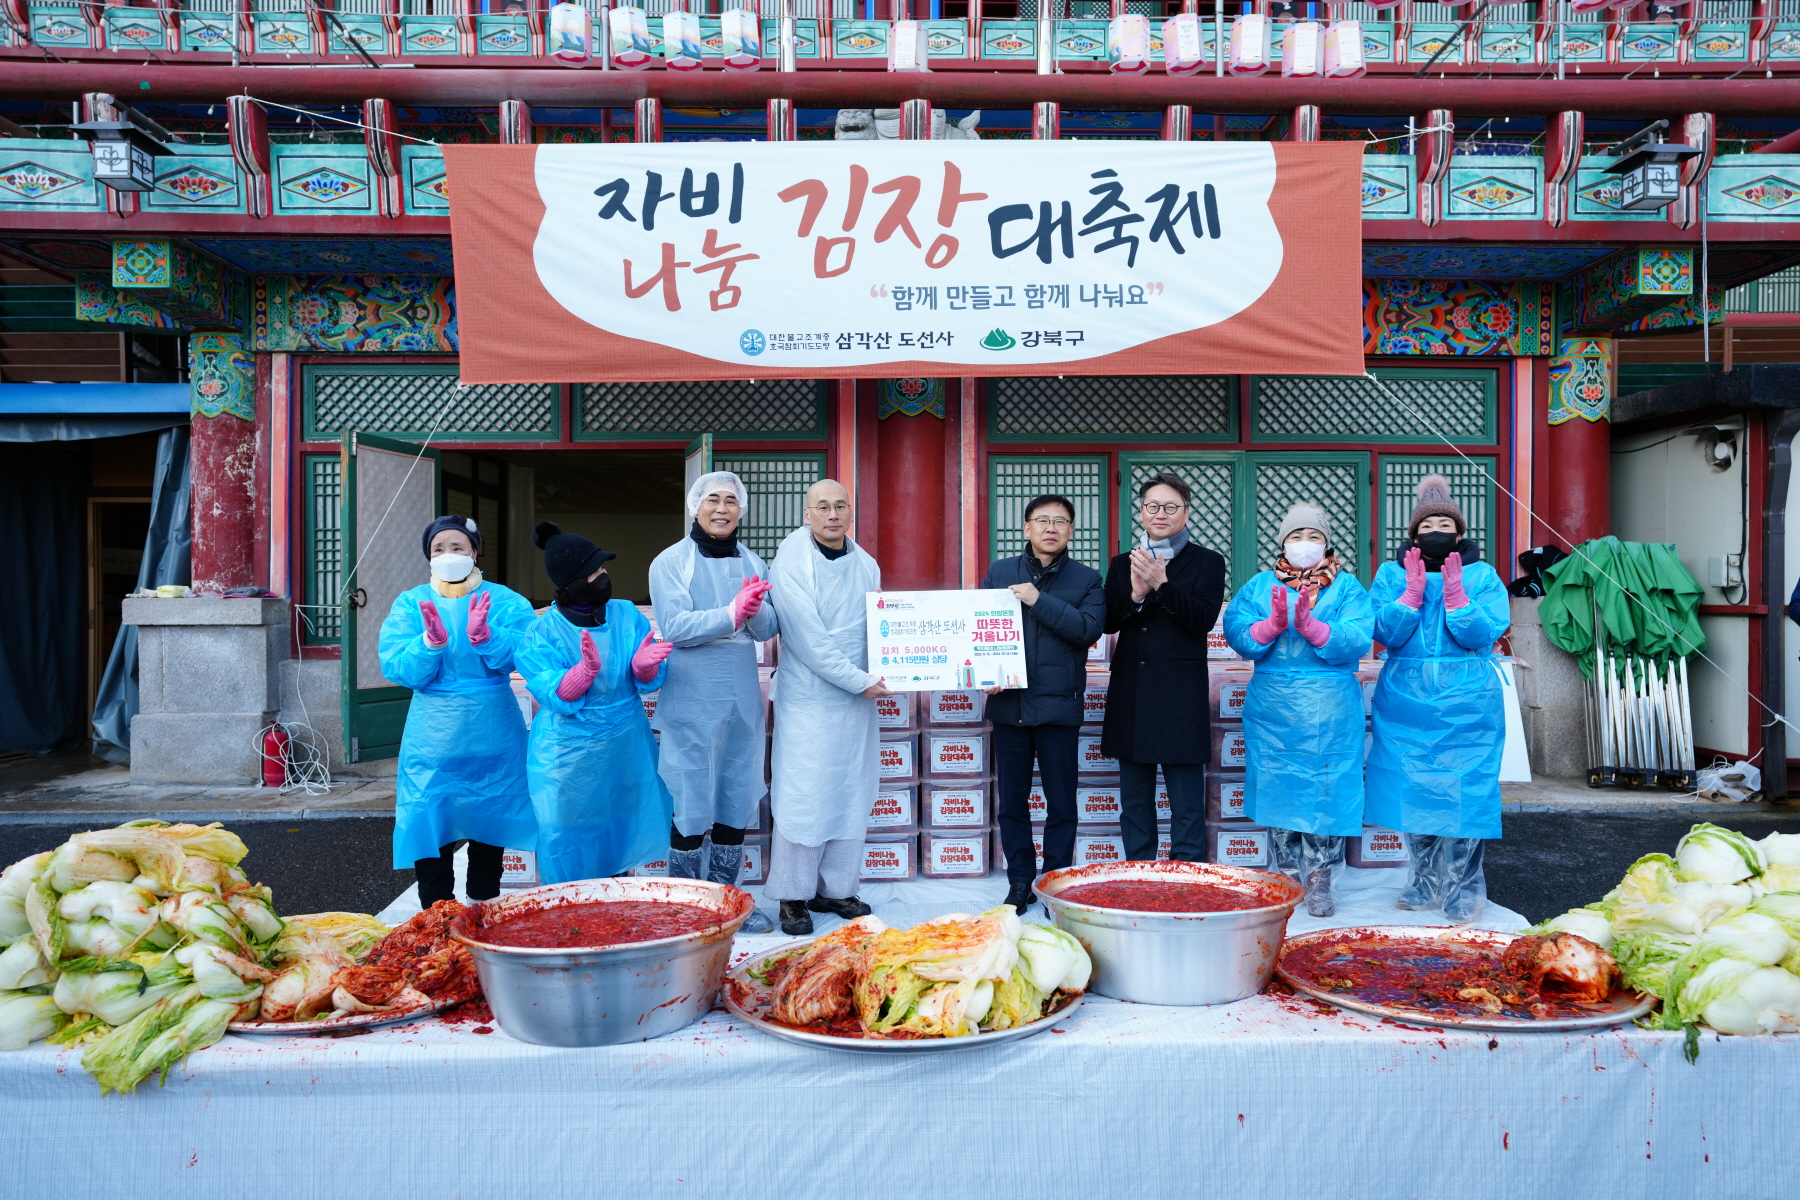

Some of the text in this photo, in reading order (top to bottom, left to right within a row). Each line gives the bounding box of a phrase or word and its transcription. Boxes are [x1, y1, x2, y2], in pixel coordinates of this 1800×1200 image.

[594, 162, 744, 231] 자비
[777, 161, 1221, 279] 김장 대축제
[623, 229, 760, 312] 나눔
[946, 285, 1017, 310] 만들고
[1023, 283, 1070, 309] 함께
[769, 332, 831, 342] 대한불교조계종
[835, 330, 955, 350] 삼각산 도선사
[1020, 330, 1085, 348] 강북구
[918, 618, 966, 636] 삼각산 도선사
[976, 618, 1014, 630] 따뜻한
[971, 630, 1021, 643] 겨울나기
[880, 645, 948, 656] 김치 5,000KG
[880, 654, 948, 666] 총 4,115만원 상당
[941, 694, 970, 703] 자비나눔
[876, 700, 897, 708] 비나눔
[938, 702, 973, 712] 김장대축제
[877, 708, 901, 717] 대축제
[942, 744, 971, 753] 자비나눔
[880, 757, 903, 766] 대축제
[939, 753, 974, 762] 김장대축제
[942, 797, 971, 806] 자비나눔
[1087, 795, 1115, 803] 자비나눔
[939, 806, 975, 815] 김장대축제
[1084, 803, 1119, 812] 김장대축제
[1373, 834, 1399, 842] 자비나눔
[1228, 838, 1256, 848] 자비나눔
[1370, 842, 1402, 850] 김장대축제
[942, 846, 971, 855] 자비나눔
[1087, 844, 1115, 852] 자비나눔
[1225, 847, 1259, 856] 김장대축제
[867, 850, 896, 859] 자비나눔
[939, 854, 974, 864] 김장대축제
[1084, 852, 1119, 860] 김장대축제
[865, 859, 900, 868] 김장대축제
